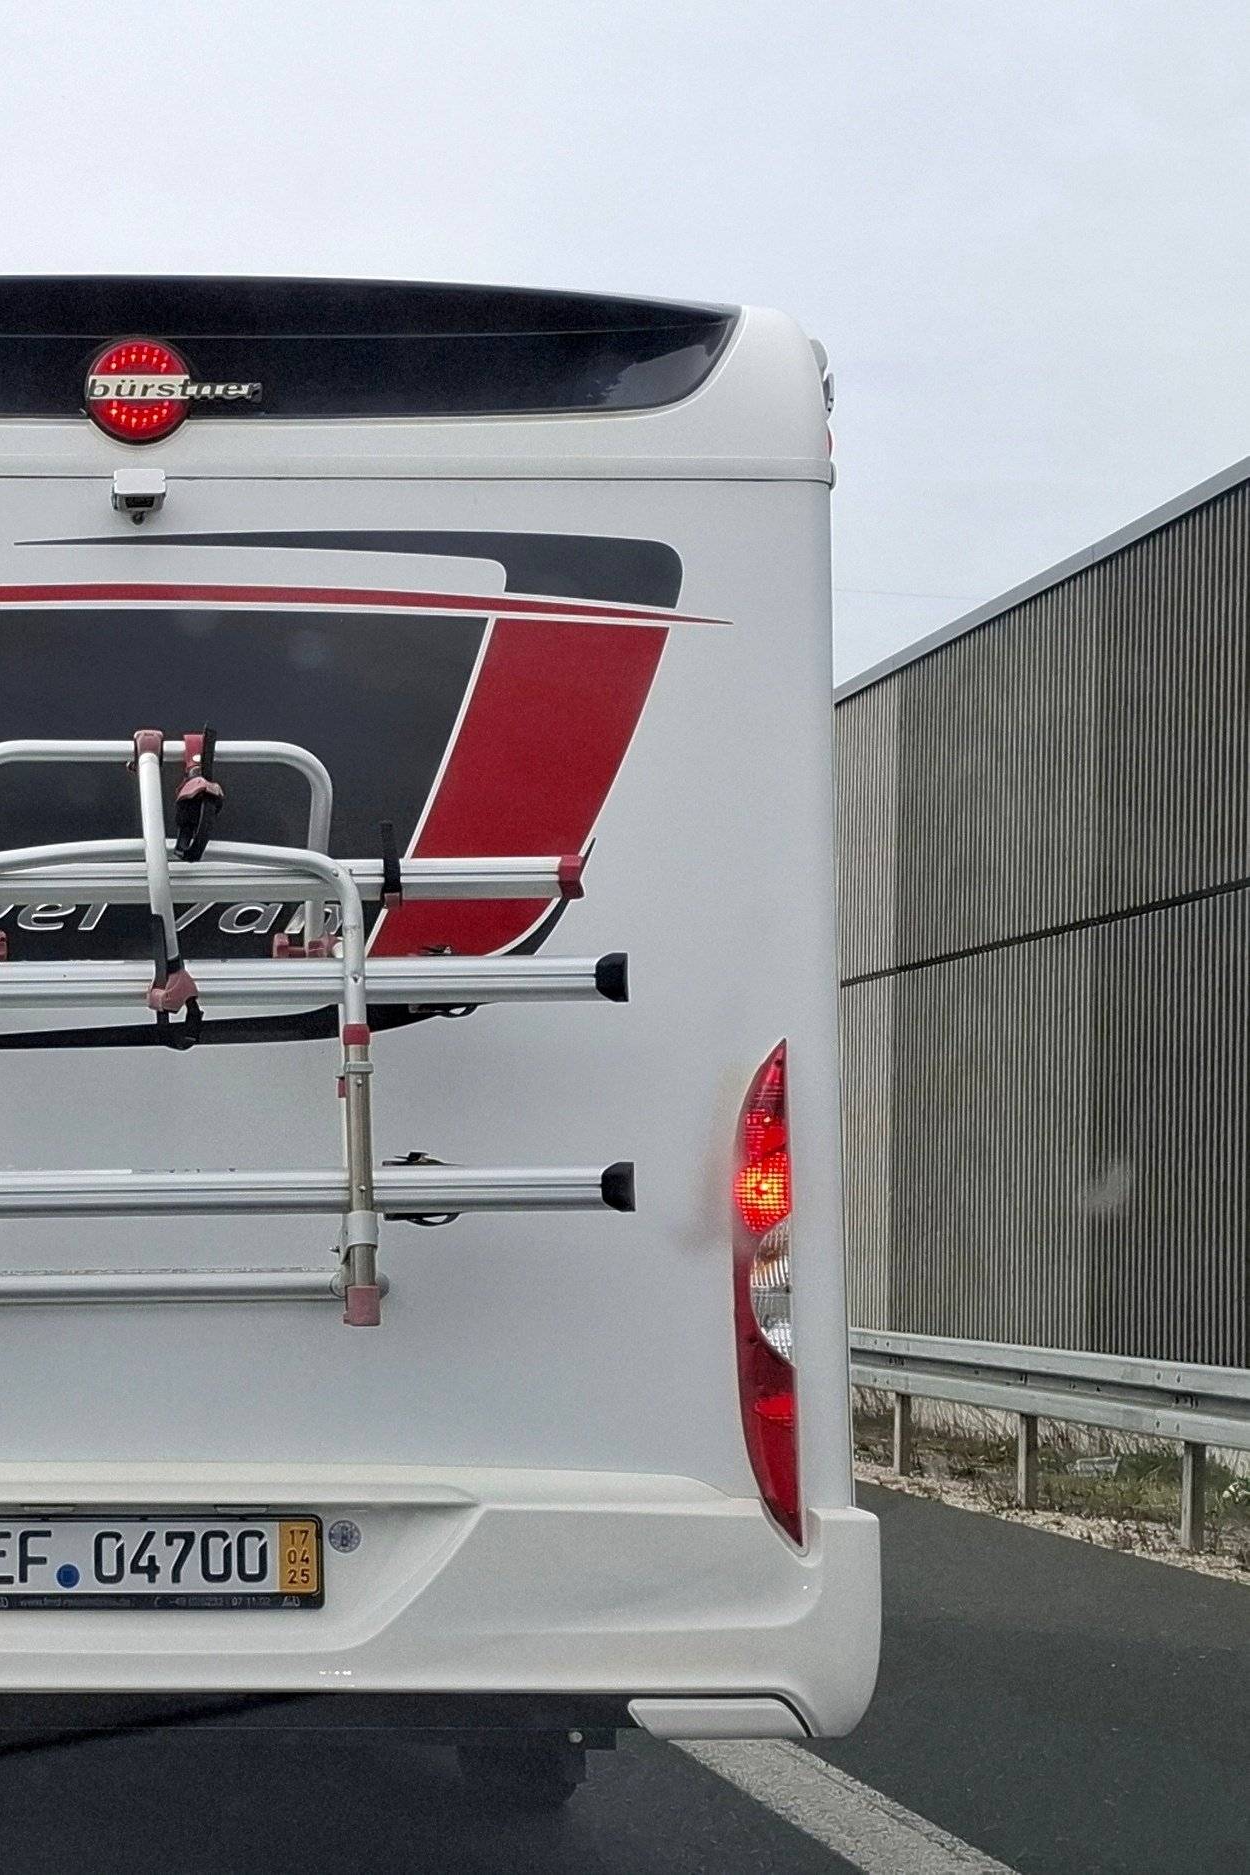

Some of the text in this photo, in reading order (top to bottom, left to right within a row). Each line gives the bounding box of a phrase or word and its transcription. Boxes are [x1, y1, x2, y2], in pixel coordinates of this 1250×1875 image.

[88, 378, 263, 402] bürstner
[289, 1529, 310, 1546] 17
[93, 1529, 269, 1584] 04700
[287, 1549, 310, 1565] 04
[287, 1568, 310, 1584] 25
